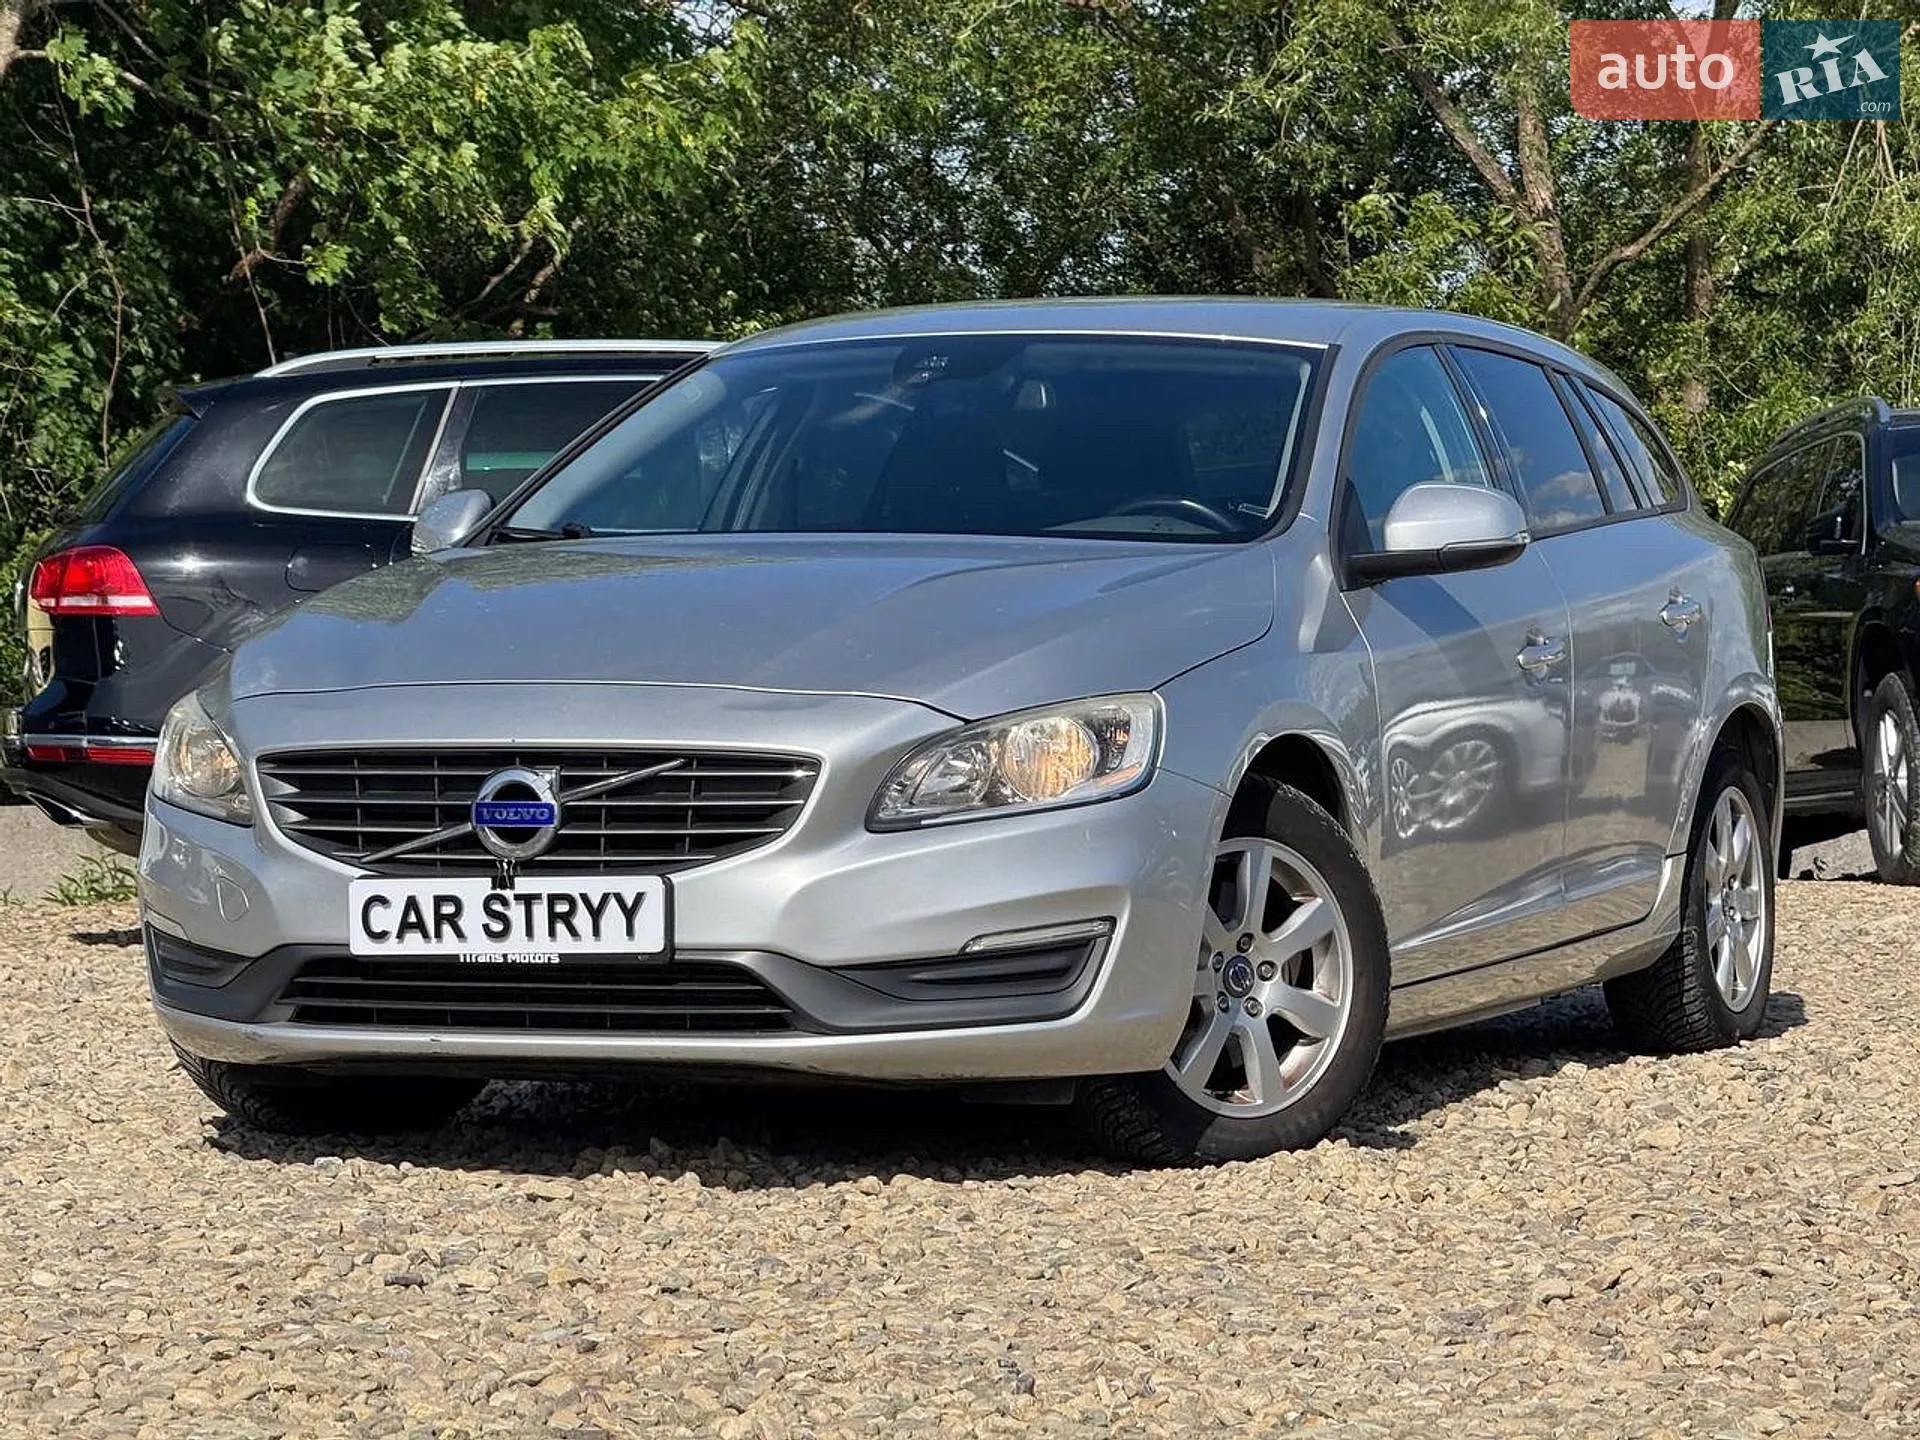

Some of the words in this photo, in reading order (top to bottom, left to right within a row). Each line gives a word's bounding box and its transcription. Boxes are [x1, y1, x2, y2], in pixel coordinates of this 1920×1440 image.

[480, 807, 550, 820] VOLVO
[361, 894, 468, 941] CAR
[481, 891, 647, 940] STRYY
[507, 953, 560, 964] Motors
